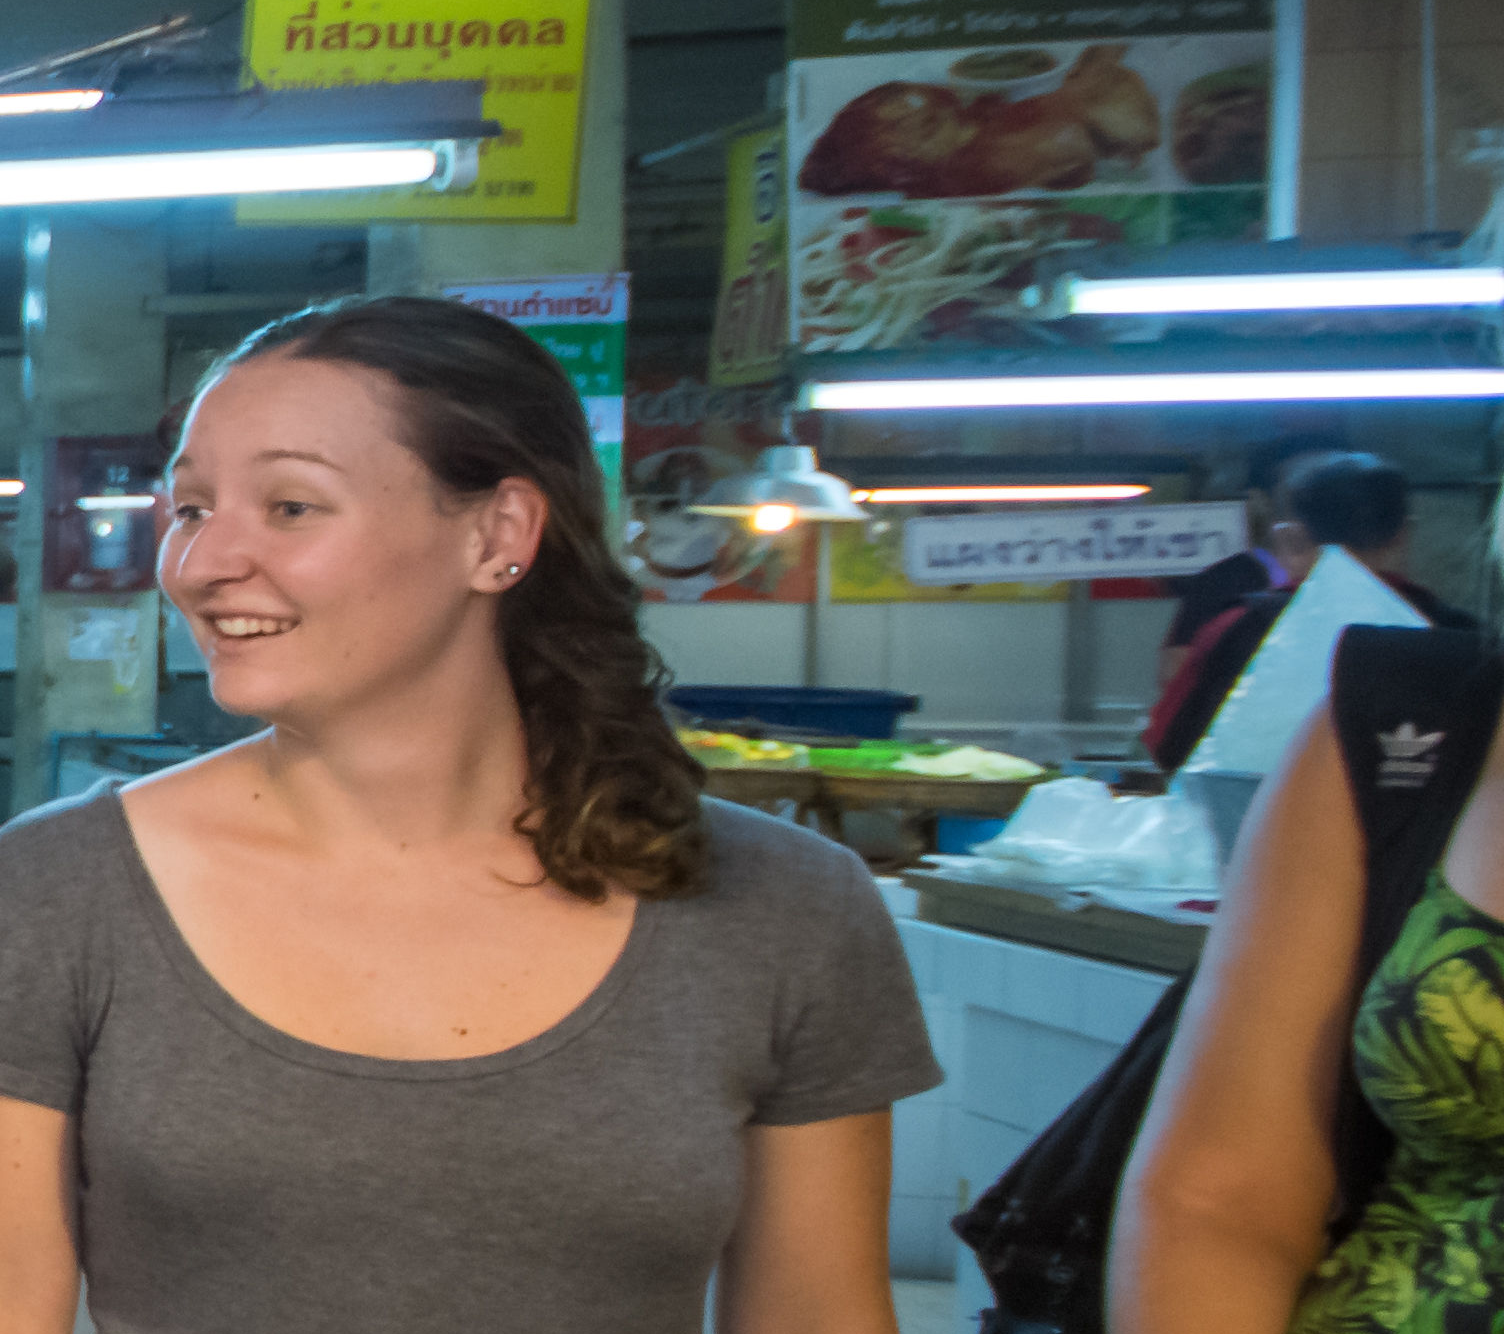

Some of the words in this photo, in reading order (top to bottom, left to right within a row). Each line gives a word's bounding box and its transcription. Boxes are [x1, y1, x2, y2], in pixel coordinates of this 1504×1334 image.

[285, 0, 567, 60] ที่ส่วนบุคคล
